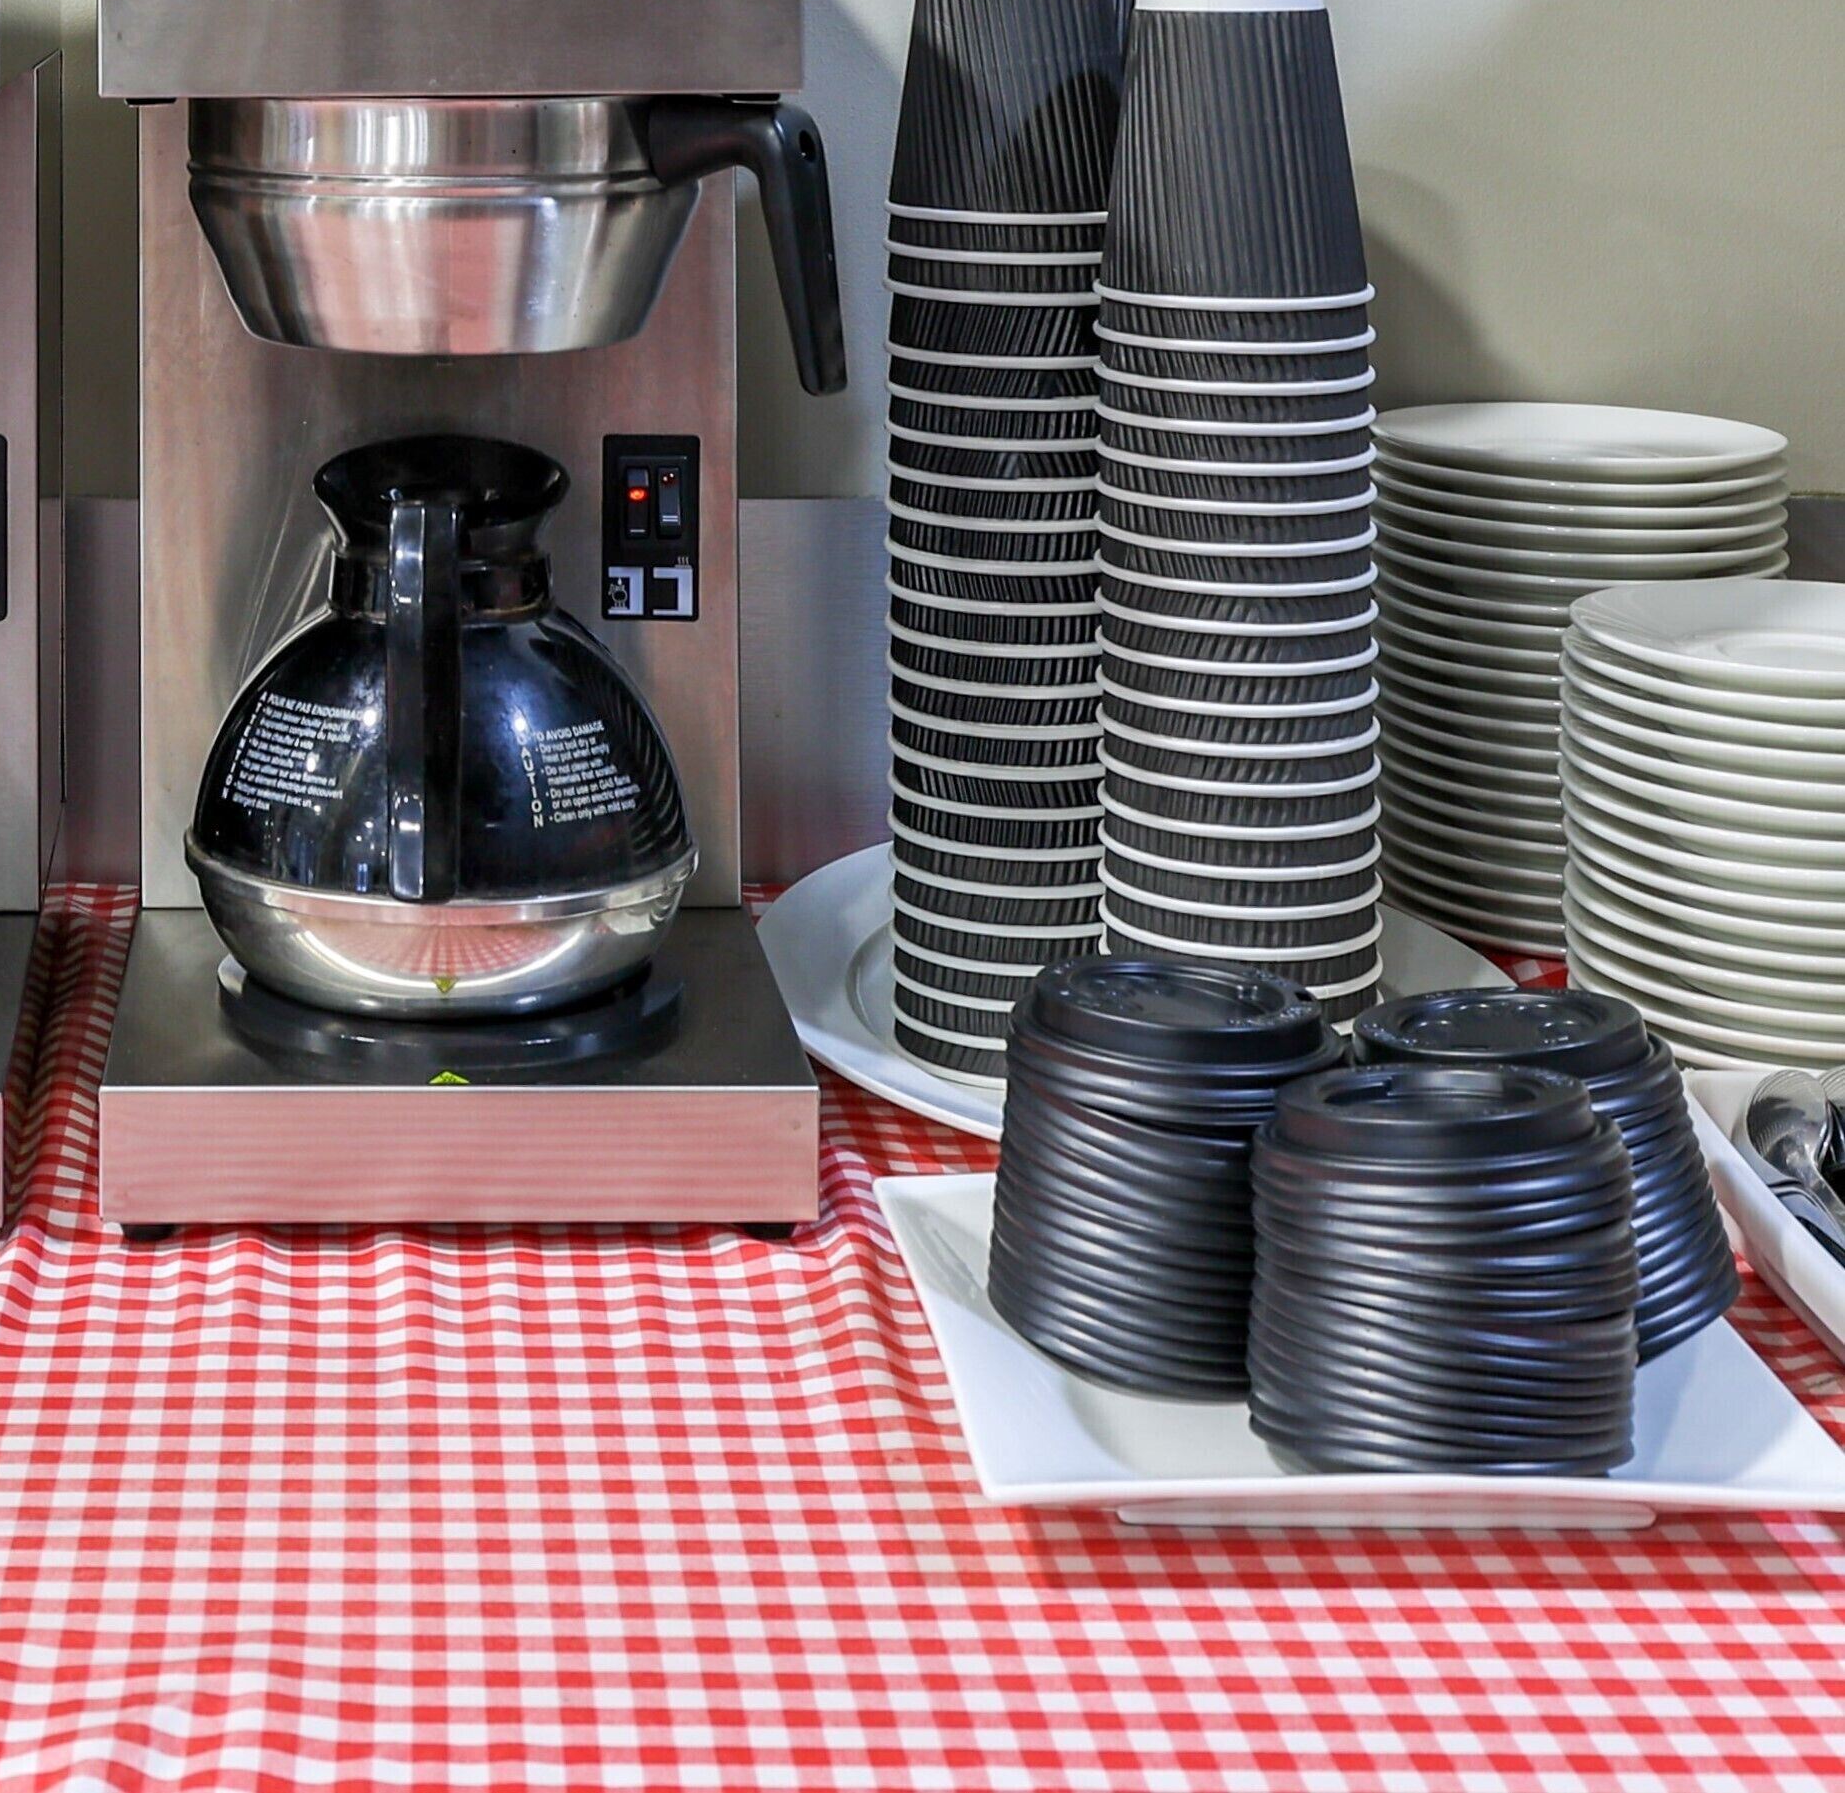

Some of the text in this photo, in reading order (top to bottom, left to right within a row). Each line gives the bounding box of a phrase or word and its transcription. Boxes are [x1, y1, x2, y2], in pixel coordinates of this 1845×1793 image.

[268, 693, 285, 706] POUR
[295, 699, 312, 714] PAS
[517, 734, 543, 828] CAUTION
